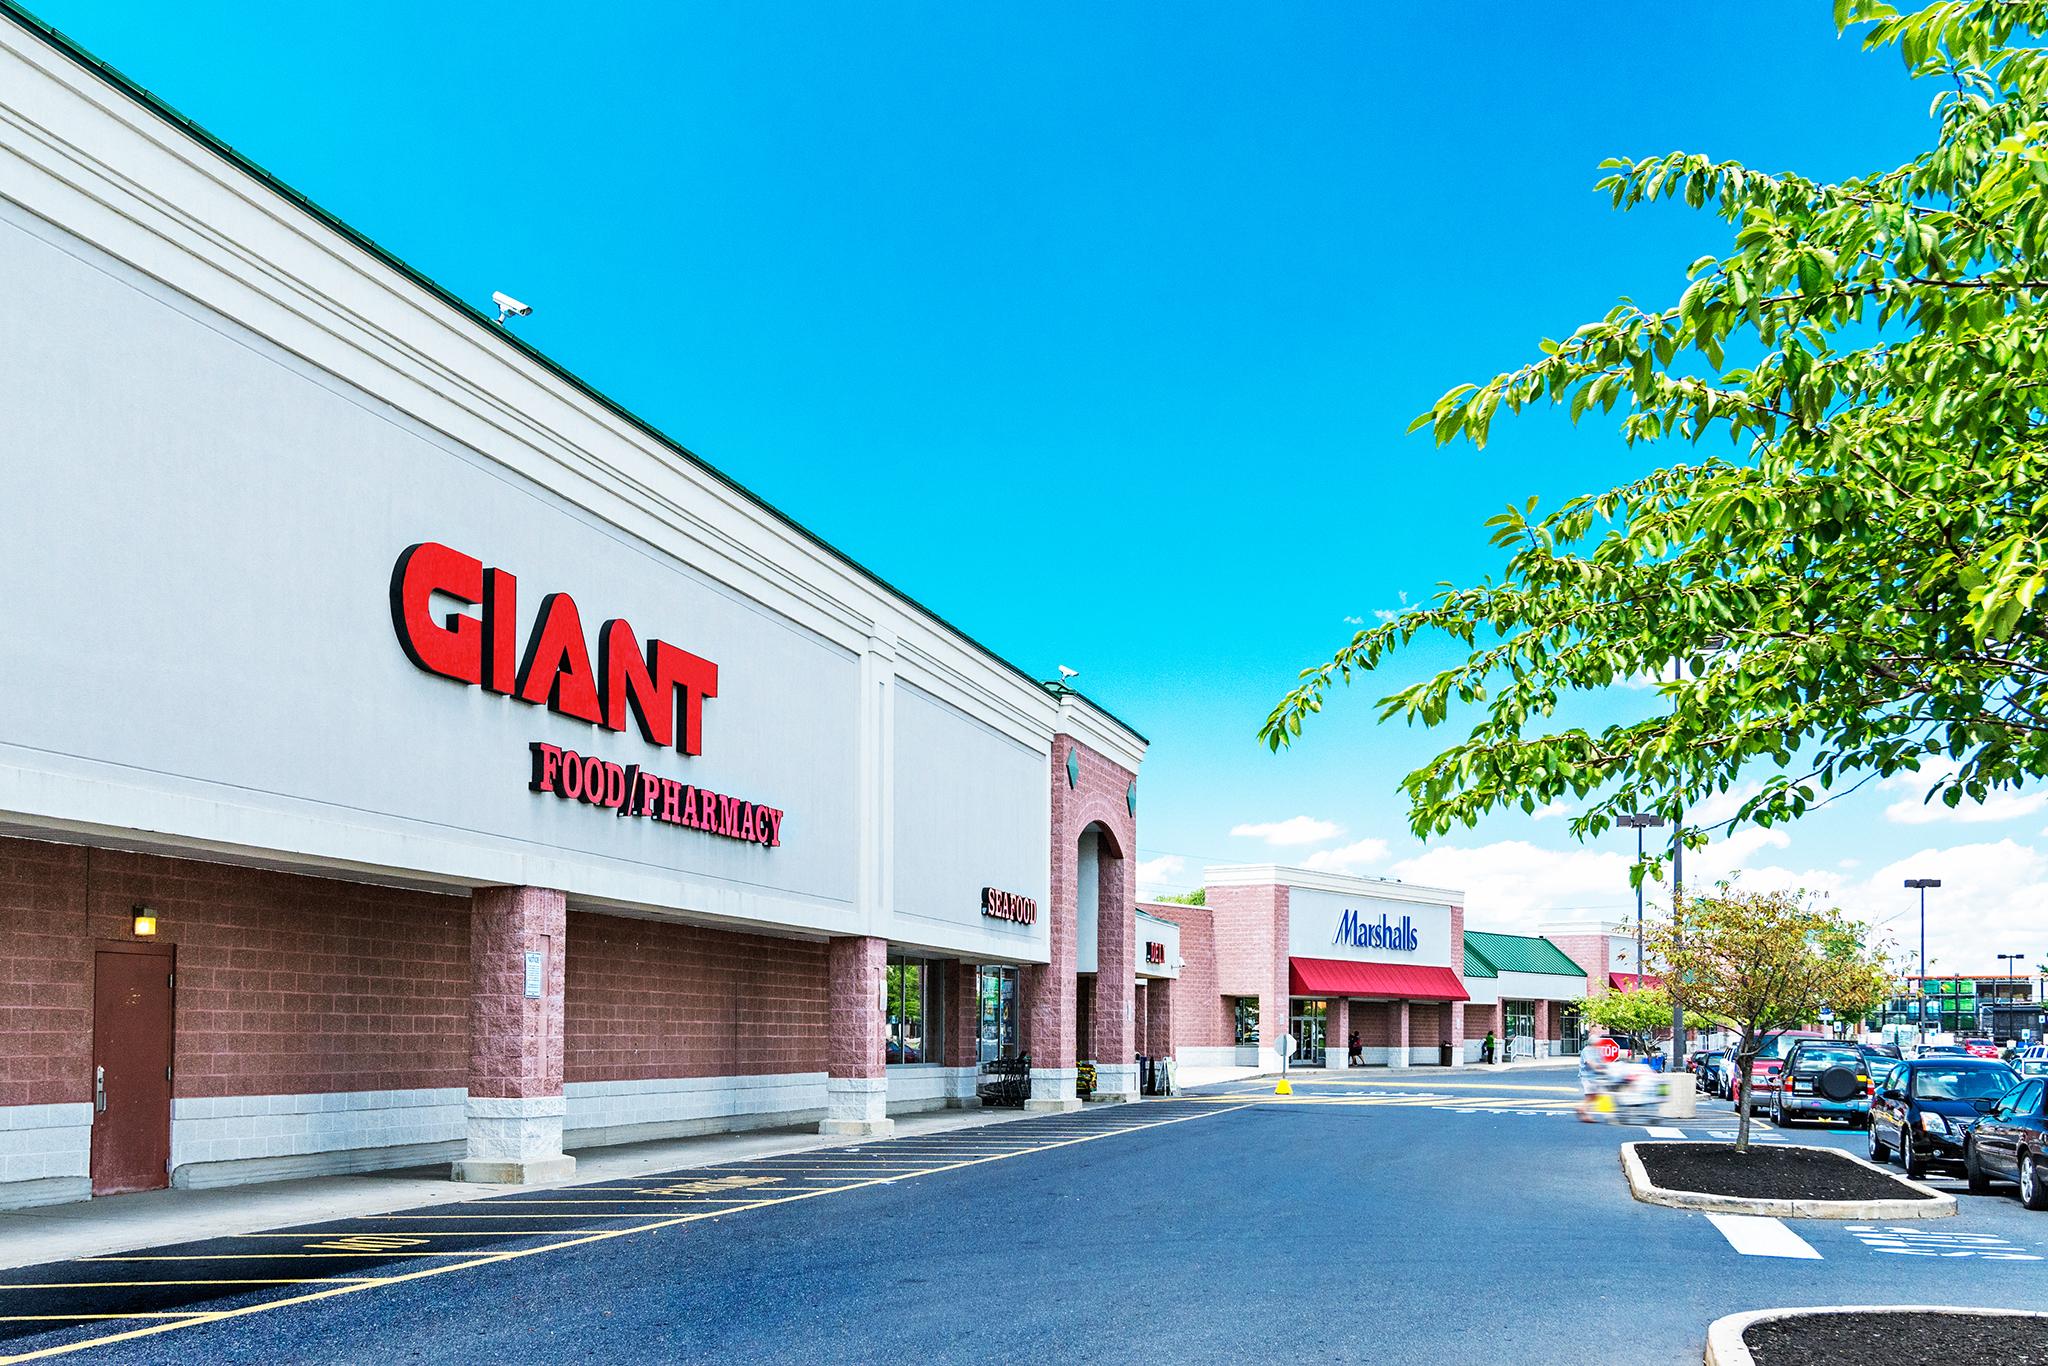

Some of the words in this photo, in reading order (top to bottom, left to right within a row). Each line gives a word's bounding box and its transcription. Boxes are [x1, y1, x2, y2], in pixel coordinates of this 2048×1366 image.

[390, 542, 718, 756] GIANT
[530, 742, 783, 847] FOOD/PHARMACY
[982, 887, 1037, 925] SEAFOOD
[1334, 909, 1418, 951] Marshalls
